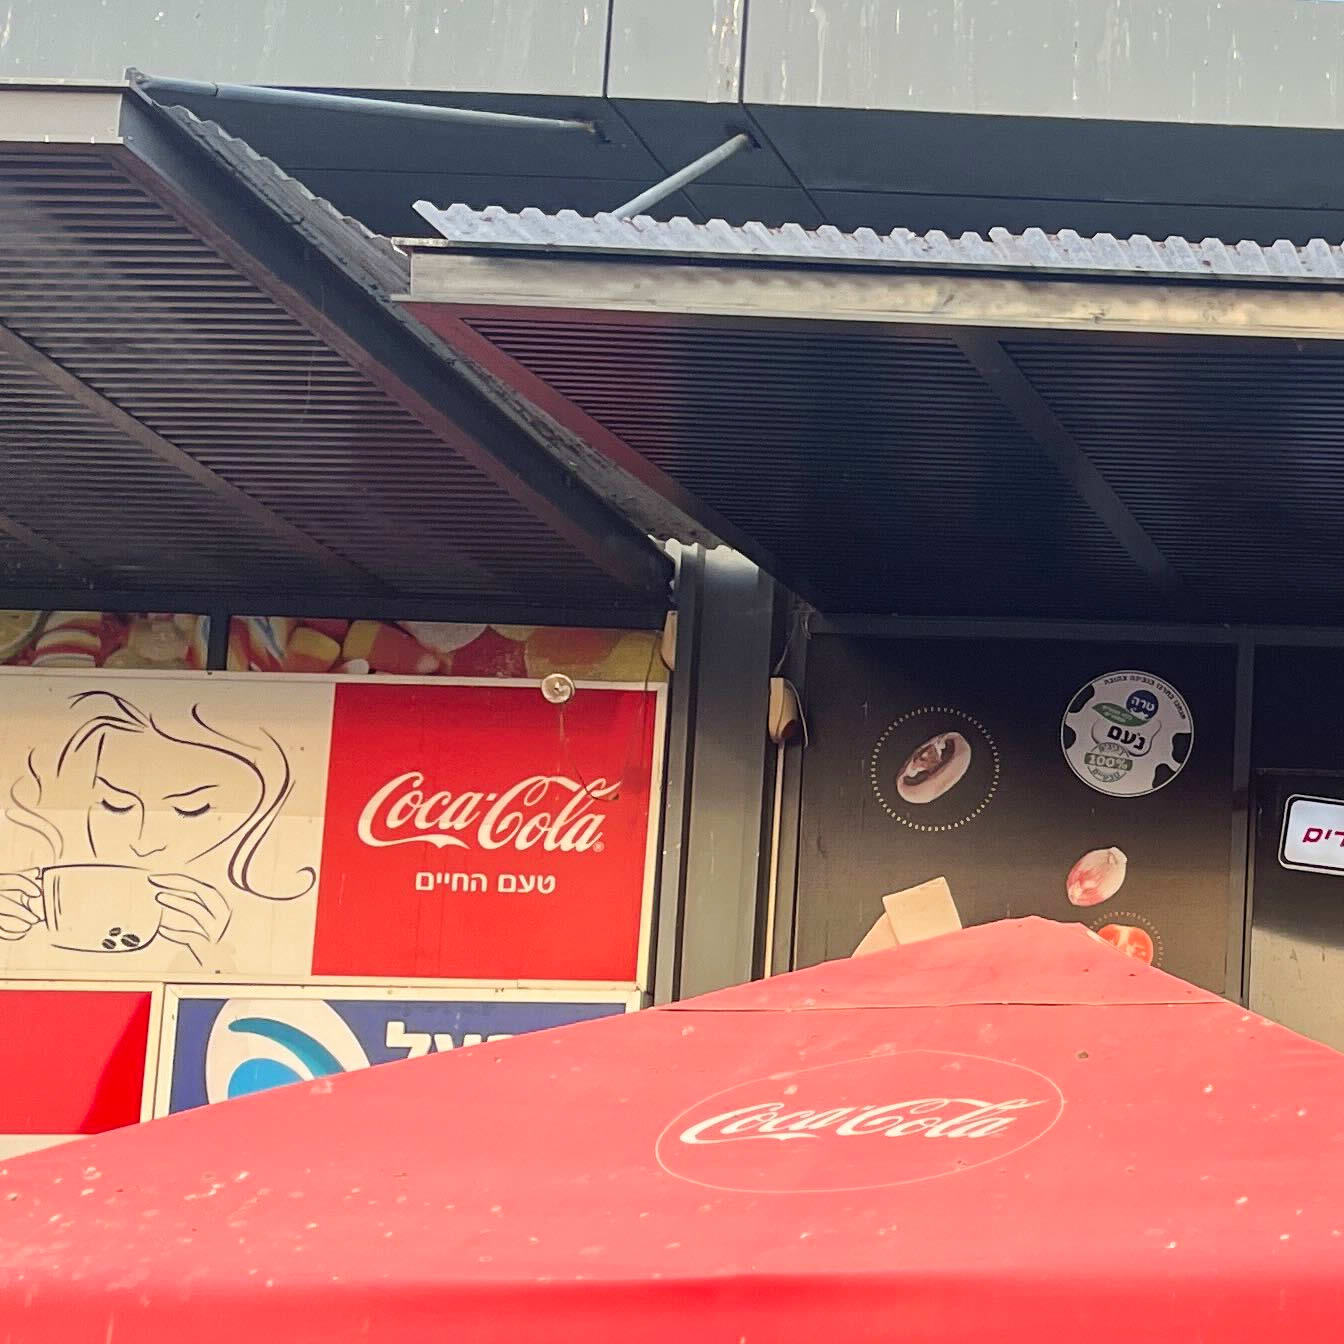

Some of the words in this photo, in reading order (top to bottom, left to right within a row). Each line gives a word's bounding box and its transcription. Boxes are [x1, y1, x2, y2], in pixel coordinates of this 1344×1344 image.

[1131, 696, 1155, 711] טרה
[357, 771, 622, 852] Coca-Cola
[415, 871, 488, 892] החיים
[497, 874, 556, 894] טעם
[679, 1098, 1050, 1144] Coca-Cola
